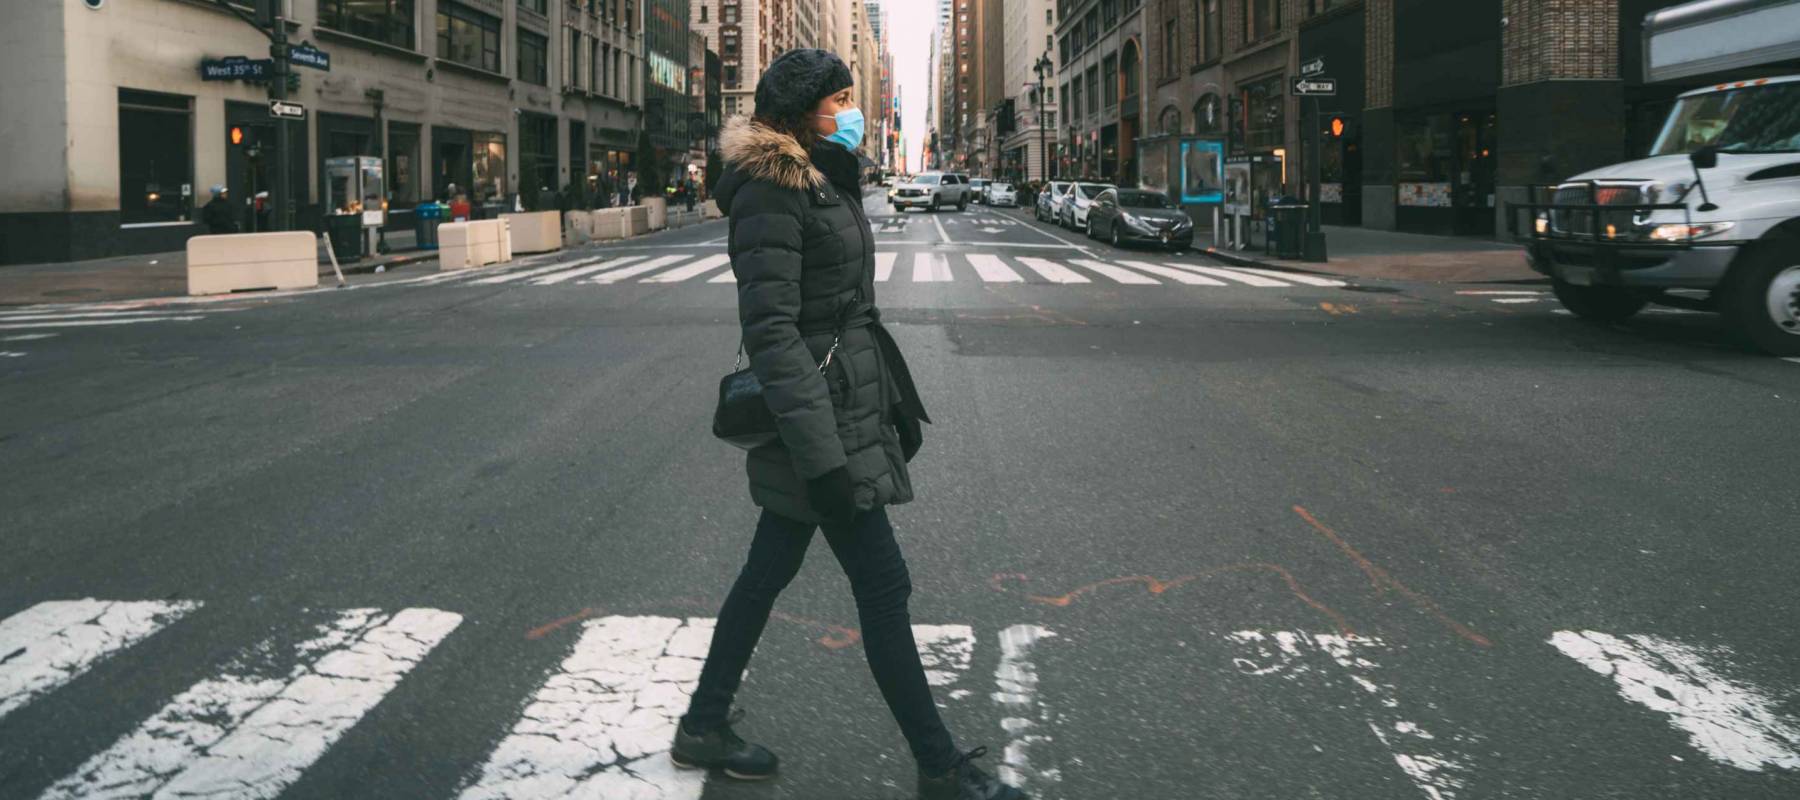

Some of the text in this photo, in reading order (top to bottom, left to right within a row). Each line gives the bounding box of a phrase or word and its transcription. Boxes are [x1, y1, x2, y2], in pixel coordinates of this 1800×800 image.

[291, 48, 316, 63] Seventh
[316, 56, 328, 67] Ave
[207, 63, 263, 76] West 35th St
